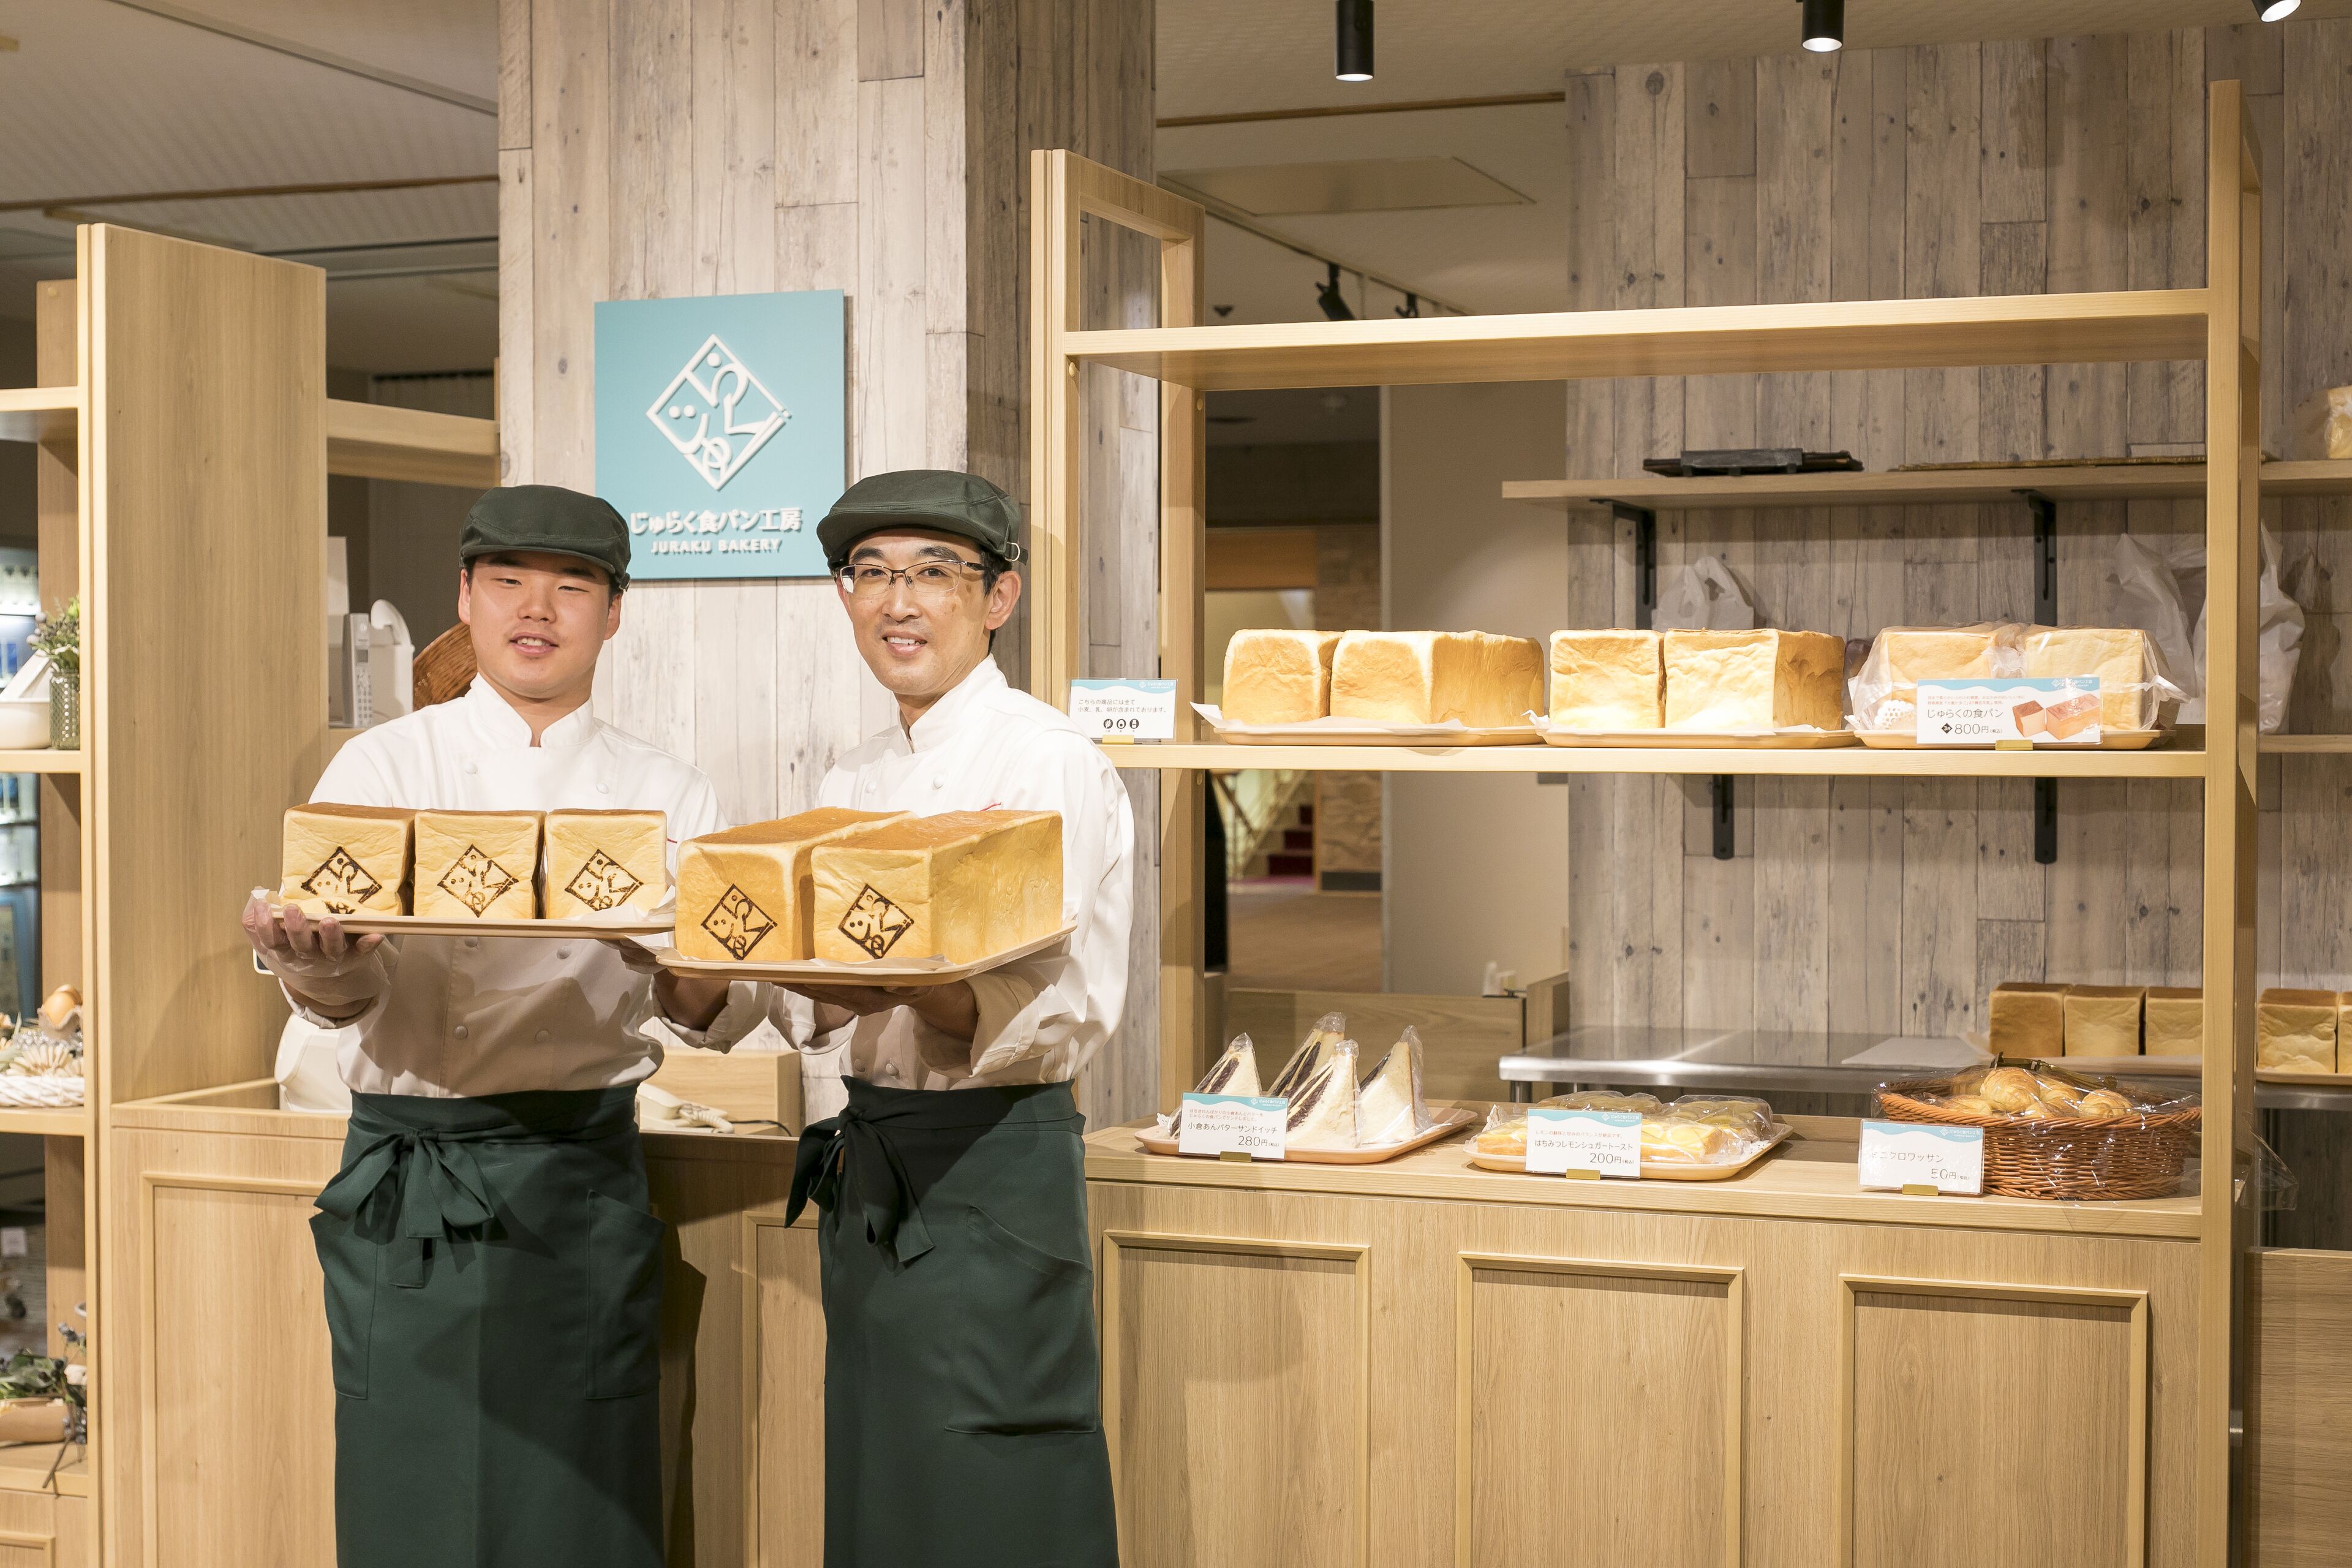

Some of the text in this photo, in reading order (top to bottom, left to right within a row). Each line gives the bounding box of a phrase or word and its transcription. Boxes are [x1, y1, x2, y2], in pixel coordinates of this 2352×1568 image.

[630, 507, 802, 534] じゅらく食パン工房
[651, 538, 782, 554] JURAKU BAKERY
[1928, 709, 2003, 718] じゅらくの食パン
[1188, 1122, 1277, 1134] 小倉あんバターサンドイッチ
[1535, 1140, 1633, 1151] はちみつレモンシュガートースト
